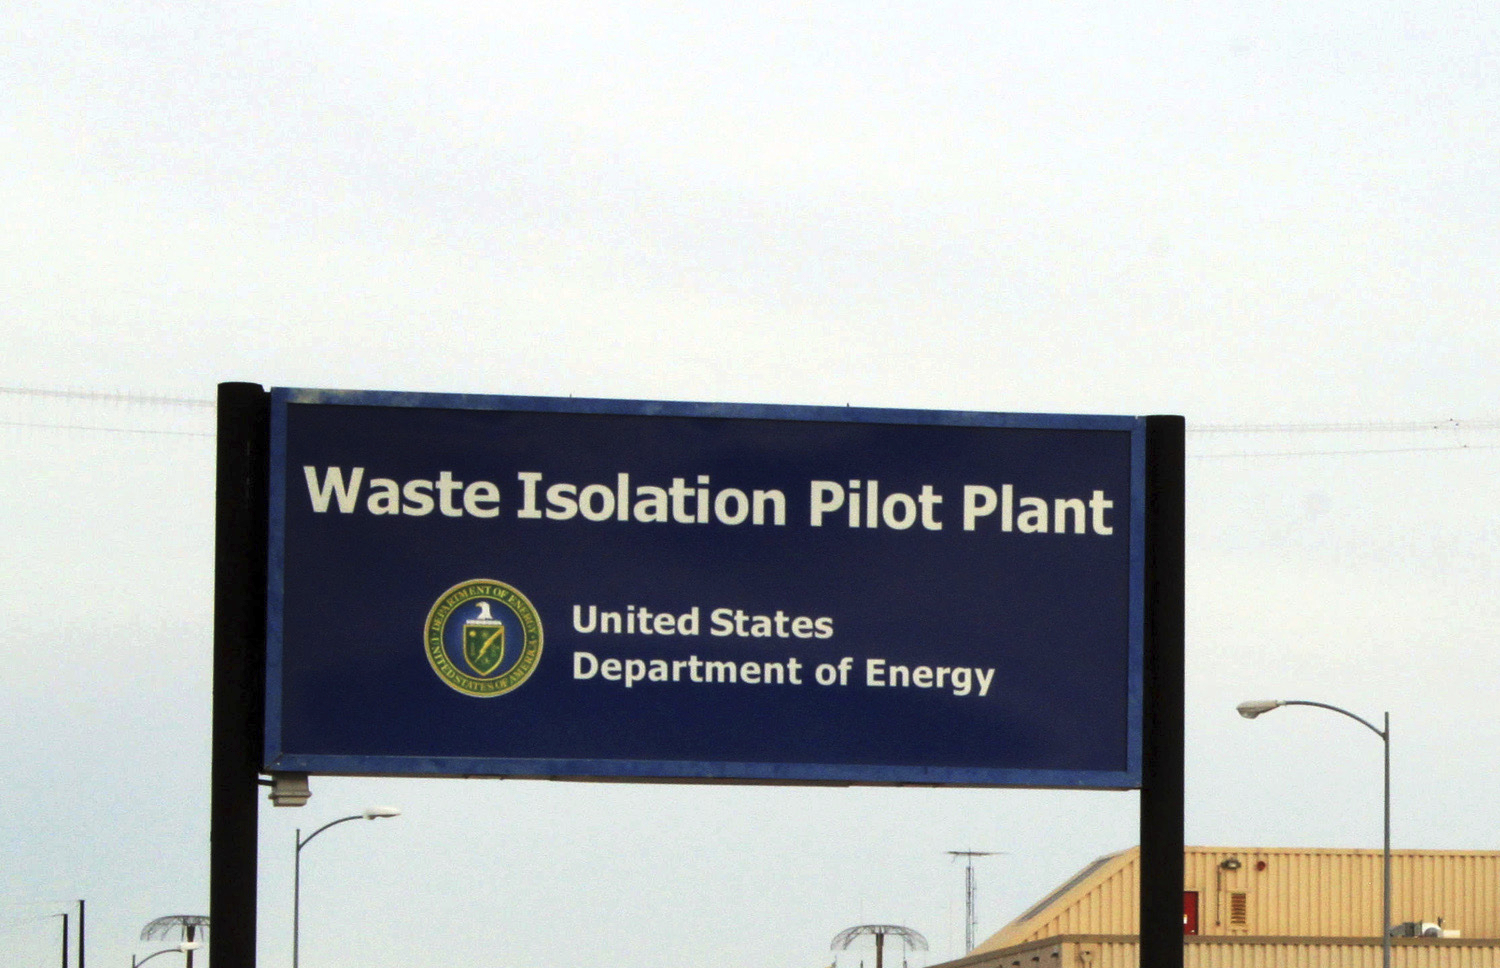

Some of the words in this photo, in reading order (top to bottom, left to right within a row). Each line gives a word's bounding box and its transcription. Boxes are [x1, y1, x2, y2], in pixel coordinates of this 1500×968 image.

[303, 465, 500, 519] Waste
[517, 471, 786, 526] Isolation
[810, 479, 943, 531] Pilot
[963, 483, 1114, 536] Plant
[432, 586, 490, 631] DEPARTMENT
[493, 586, 508, 598] OF
[508, 594, 537, 635] ENERGY
[572, 604, 700, 636] United
[710, 607, 834, 639] States
[431, 637, 455, 678] UNITED
[454, 675, 494, 691] STATES
[494, 678, 508, 690] OF
[573, 651, 803, 688] Department
[814, 656, 854, 686] of
[866, 658, 996, 697] Energy
